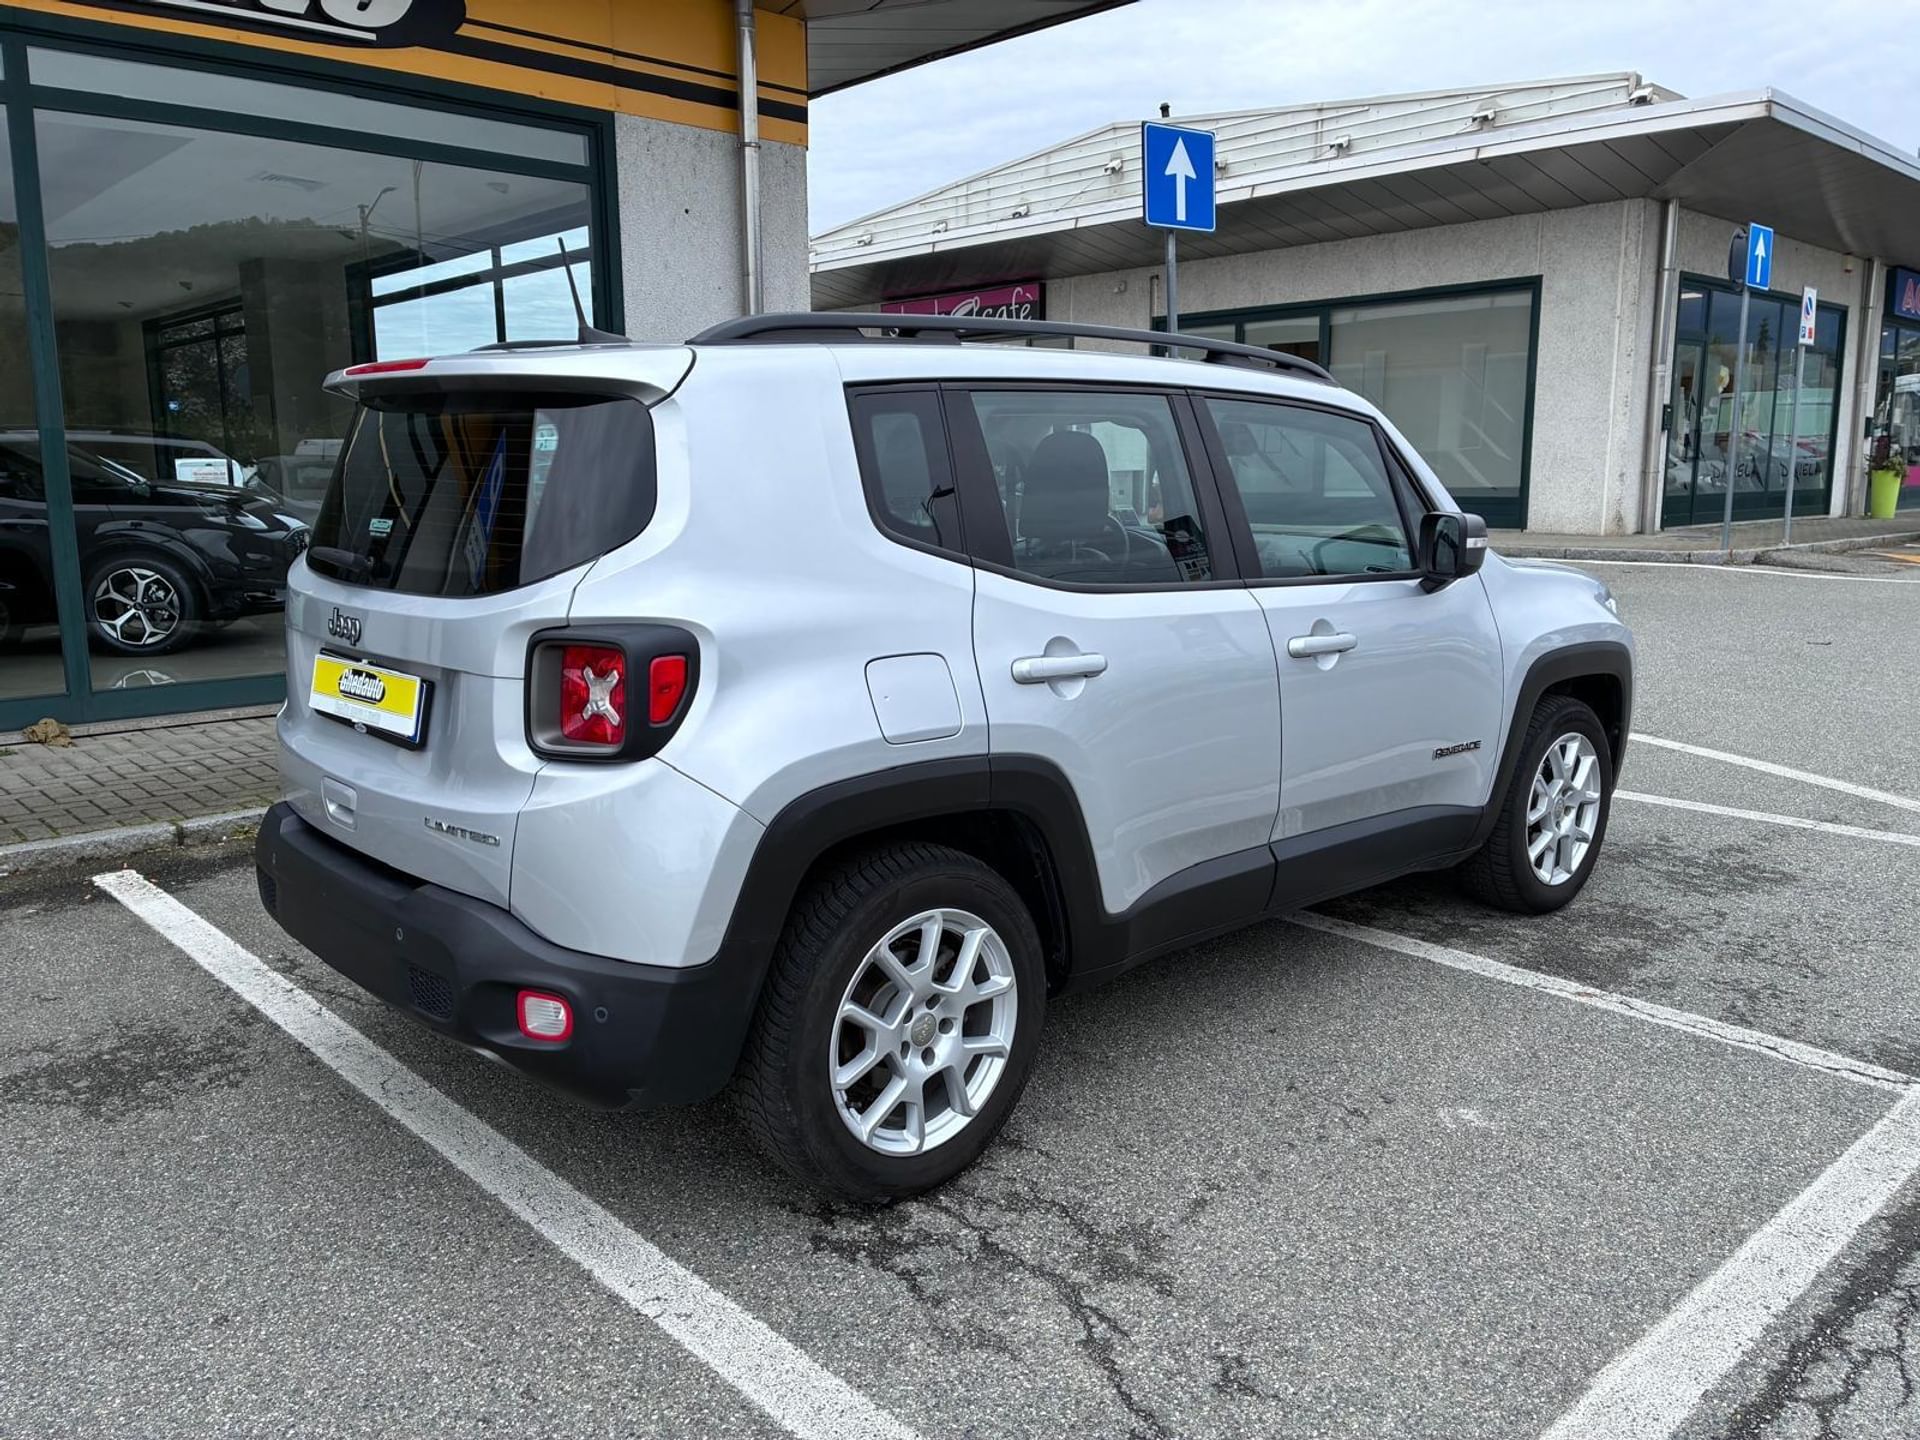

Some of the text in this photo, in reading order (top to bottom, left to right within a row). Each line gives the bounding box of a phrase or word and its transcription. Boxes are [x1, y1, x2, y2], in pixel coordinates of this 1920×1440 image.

[328, 607, 361, 646] Jeep
[340, 668, 385, 701] Ghedauto
[1432, 740, 1482, 760] RENEGADE
[424, 816, 501, 847] LIMITED
